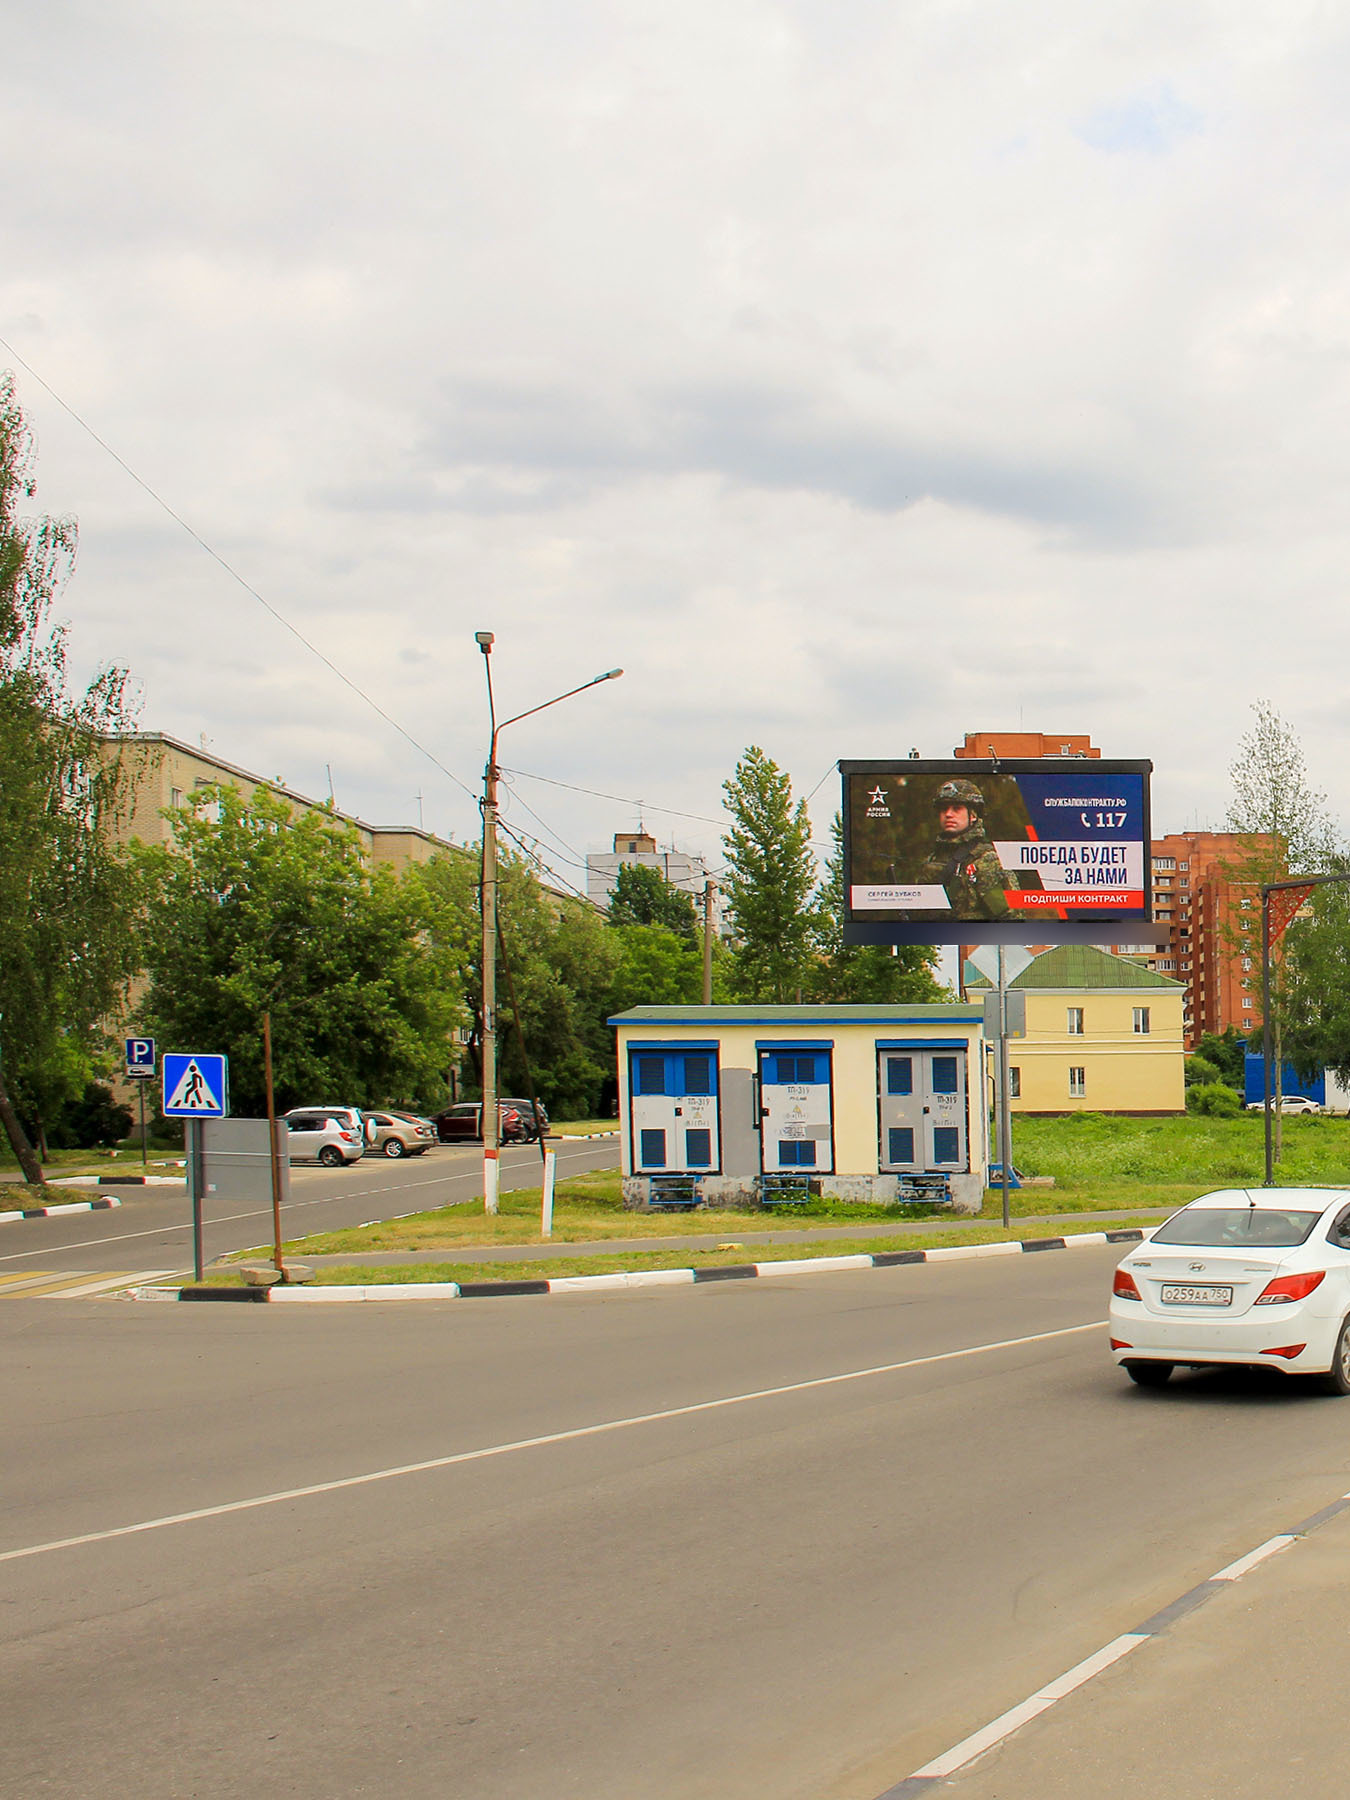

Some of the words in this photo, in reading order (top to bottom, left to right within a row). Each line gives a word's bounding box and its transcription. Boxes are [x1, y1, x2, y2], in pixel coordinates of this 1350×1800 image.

[1096, 812, 1127, 828] 117
[1020, 846, 1077, 865] ПОБЕДА
[1081, 846, 1127, 865] БУДЕТ
[1064, 868, 1082, 885] ЗА
[1087, 868, 1127, 885] НАМИ
[1023, 895, 1076, 904] ПОДПИШИ
[1078, 895, 1128, 904] КОНТРАКТ
[132, 1041, 150, 1064] P
